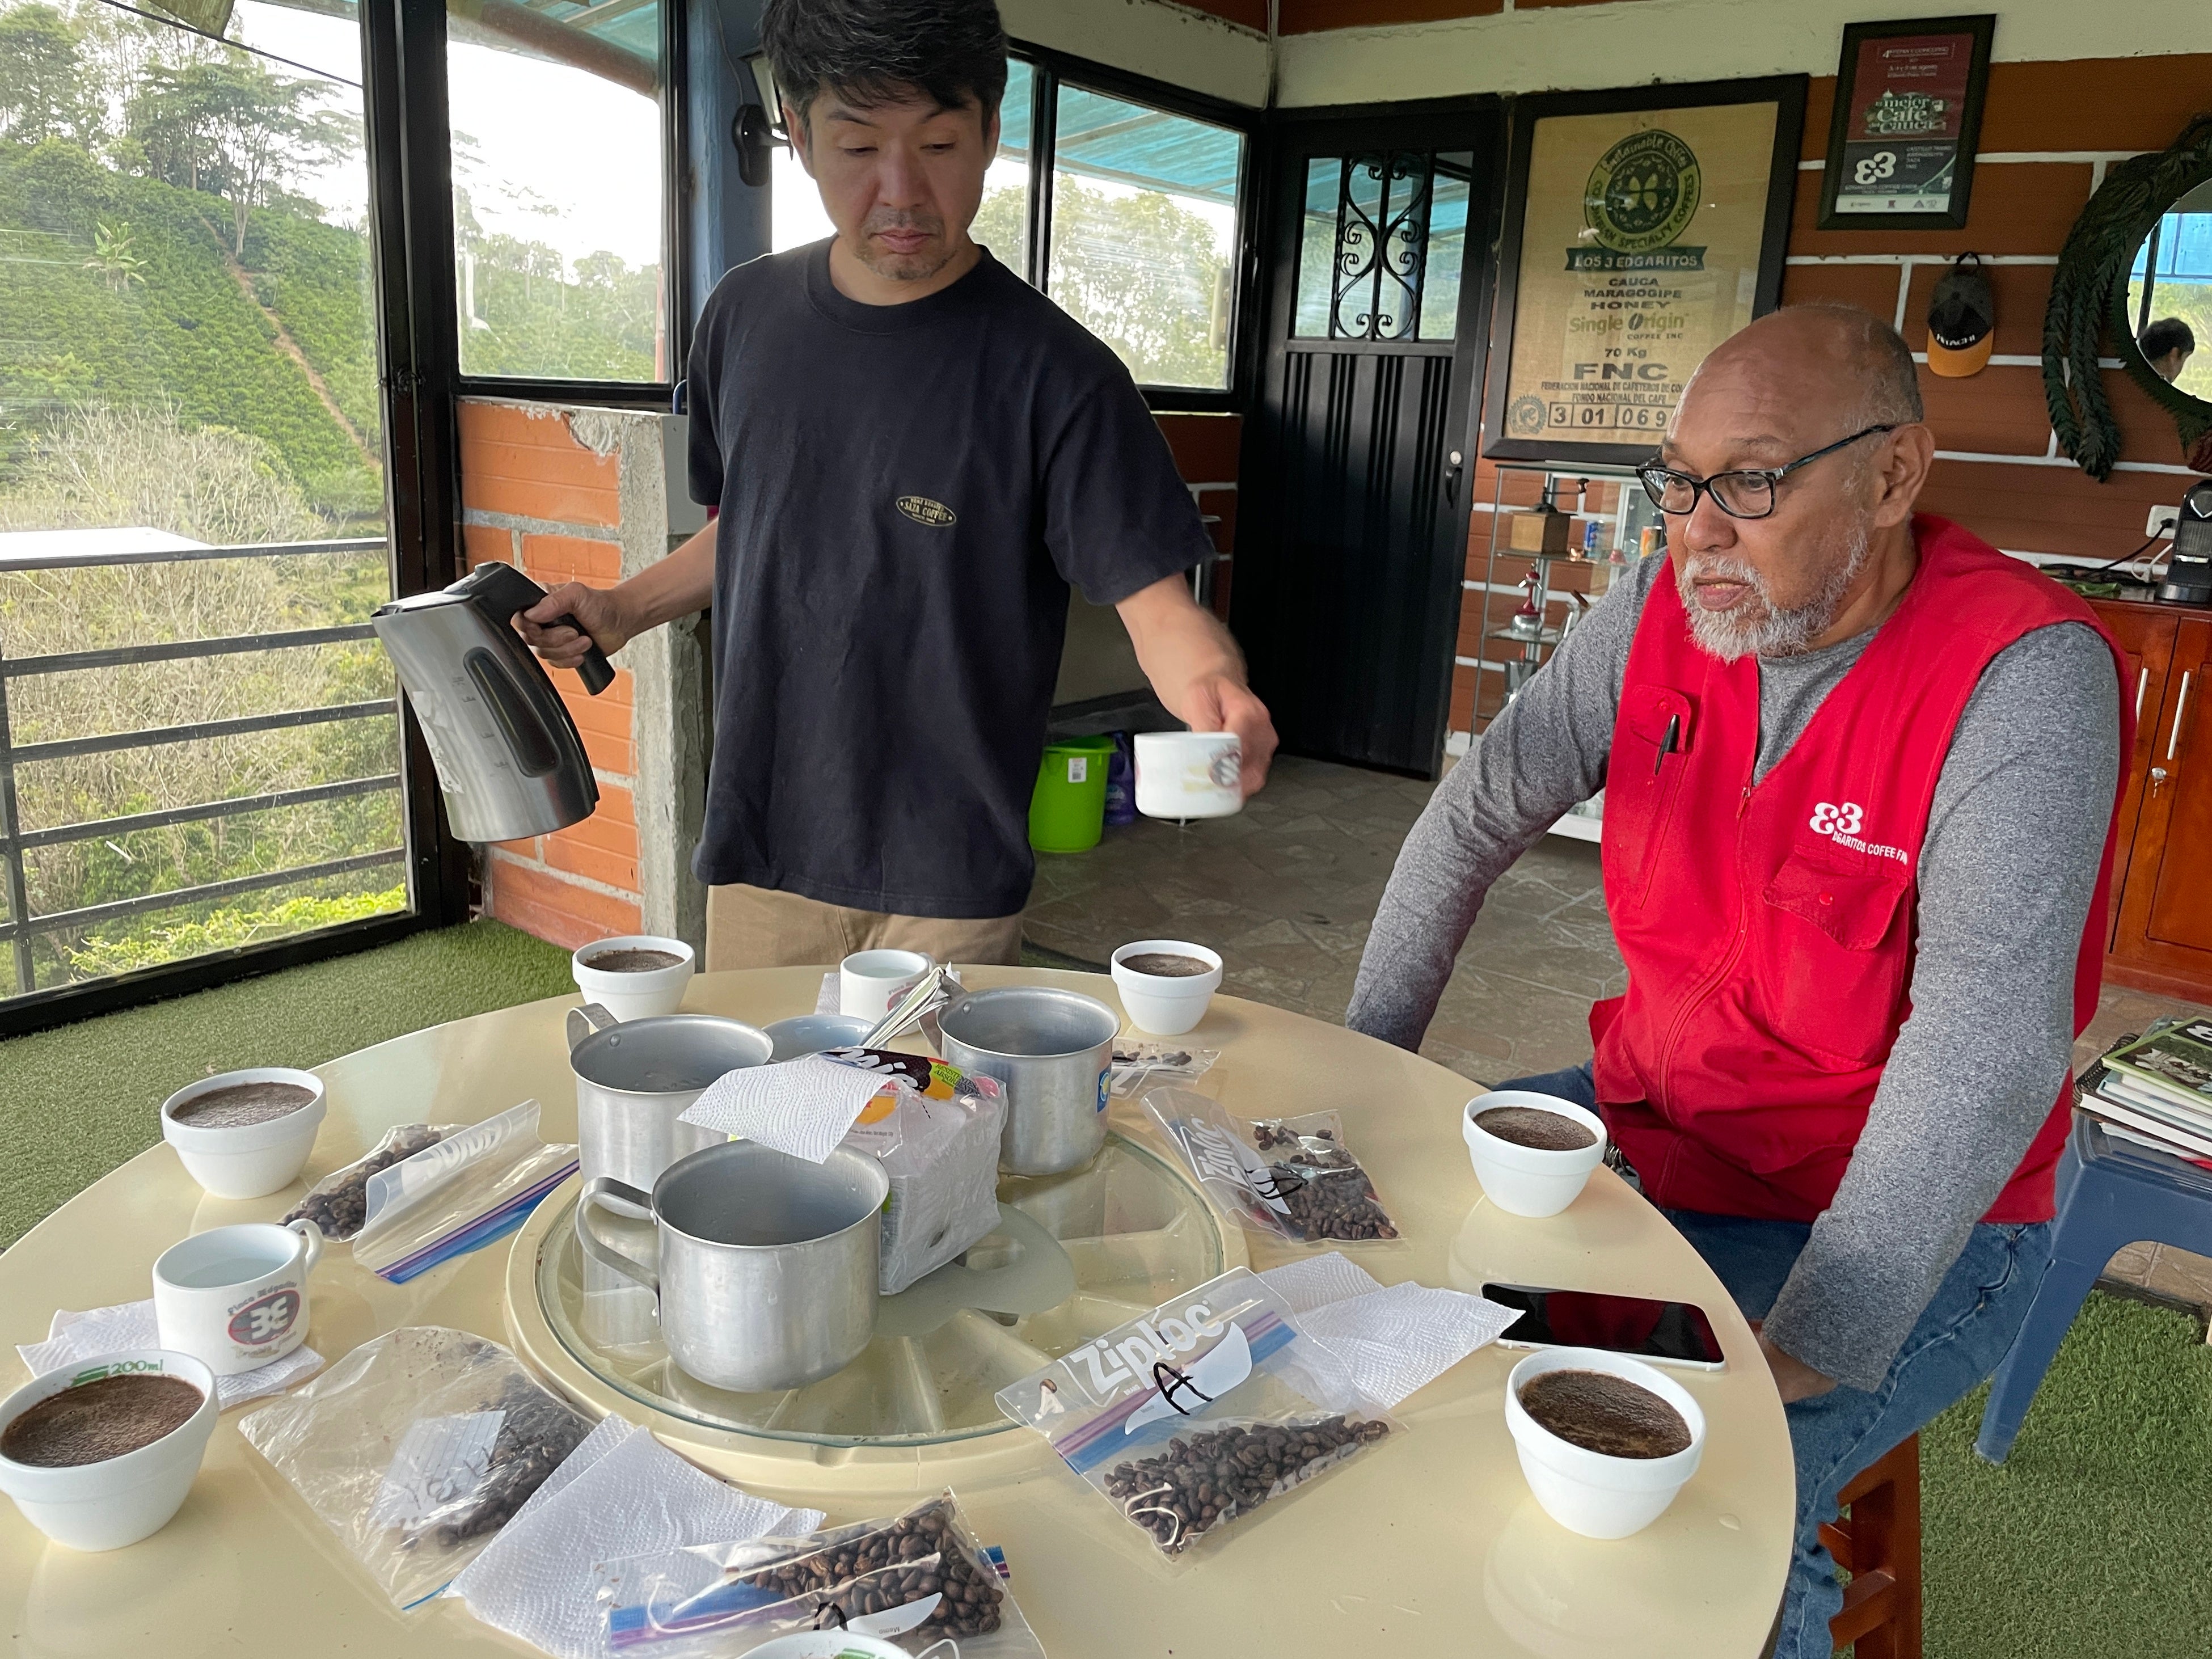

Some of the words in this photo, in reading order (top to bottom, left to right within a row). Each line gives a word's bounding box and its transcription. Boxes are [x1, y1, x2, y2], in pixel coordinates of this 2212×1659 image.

[1574, 256, 1602, 268] LOS
[1605, 256, 1613, 268] 3
[1616, 255, 1698, 268] EDGARITOS
[1608, 276, 1660, 286] CAUCA
[1584, 288, 1683, 299] MARAGOGIPE
[1590, 301, 1671, 310] HONEY
[1568, 314, 1624, 336] Single
[1604, 347, 1622, 358] 70
[1626, 347, 1648, 358] Kg
[1573, 362, 1670, 381] FNC
[1580, 381, 1611, 391] NACIONAL
[1596, 392, 1631, 404] NACIONAL
[1633, 393, 1646, 403] DEL
[1554, 406, 1567, 424] 3
[1581, 408, 1605, 425] 01
[904, 501, 920, 514] SAZA
[922, 506, 948, 522] COFFEE
[1069, 1304, 1225, 1395] Ziploc
[110, 1359, 164, 1375] 200ml
